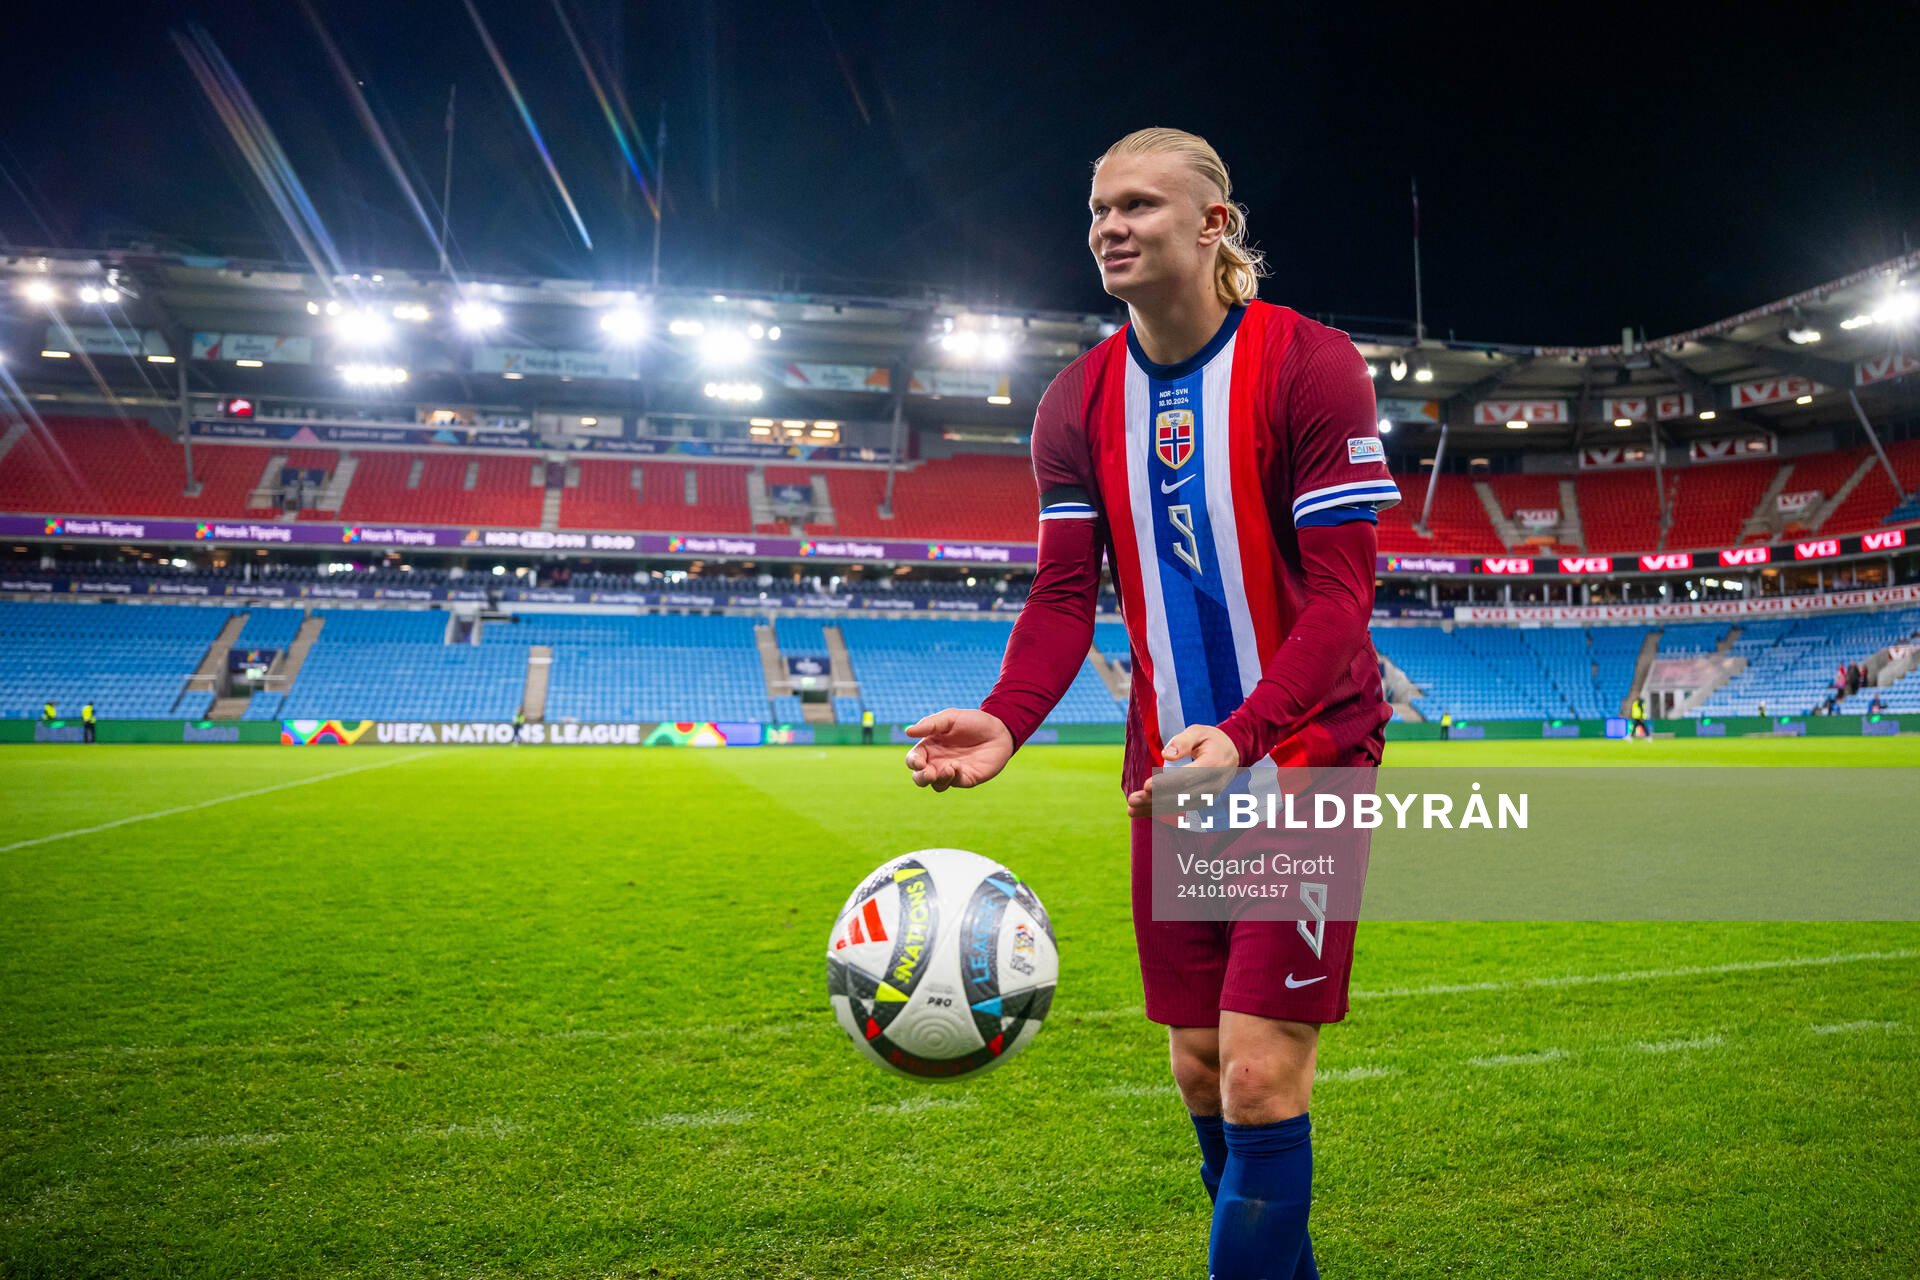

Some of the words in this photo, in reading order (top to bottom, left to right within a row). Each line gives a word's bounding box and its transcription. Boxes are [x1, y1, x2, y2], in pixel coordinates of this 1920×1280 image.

[1160, 390, 1171, 398] NOR
[1175, 388, 1189, 396] SVN
[1158, 397, 1189, 407] 10.10.2024
[1484, 402, 1559, 422] VG
[64, 520, 99, 534] Norsk
[101, 521, 145, 538] Tipping
[215, 525, 248, 539] Norsk
[249, 526, 291, 543] Tipping
[361, 529, 393, 542] Norsk
[394, 529, 436, 545] Tipping
[686, 538, 717, 552] Norsk
[717, 539, 756, 555] Tipping
[1167, 504, 1203, 576] 9
[1864, 531, 1903, 550] VG
[815, 542, 846, 556] Norsk
[847, 543, 884, 558] Tipping
[944, 546, 973, 559] Norsk
[974, 547, 1009, 562] Tipping
[1722, 548, 1768, 565] VG
[1796, 540, 1838, 558] VG
[1401, 559, 1427, 571] Norsk
[1427, 560, 1455, 573] Tipping
[1485, 558, 1529, 574] VG
[1561, 558, 1611, 573] VG
[1642, 554, 1690, 571] VG
[376, 723, 438, 743] UEFA
[441, 723, 545, 743] NATIONS
[551, 724, 640, 743] LEAGUE
[896, 881, 928, 980] NATIONS
[927, 996, 952, 1008] PRO
